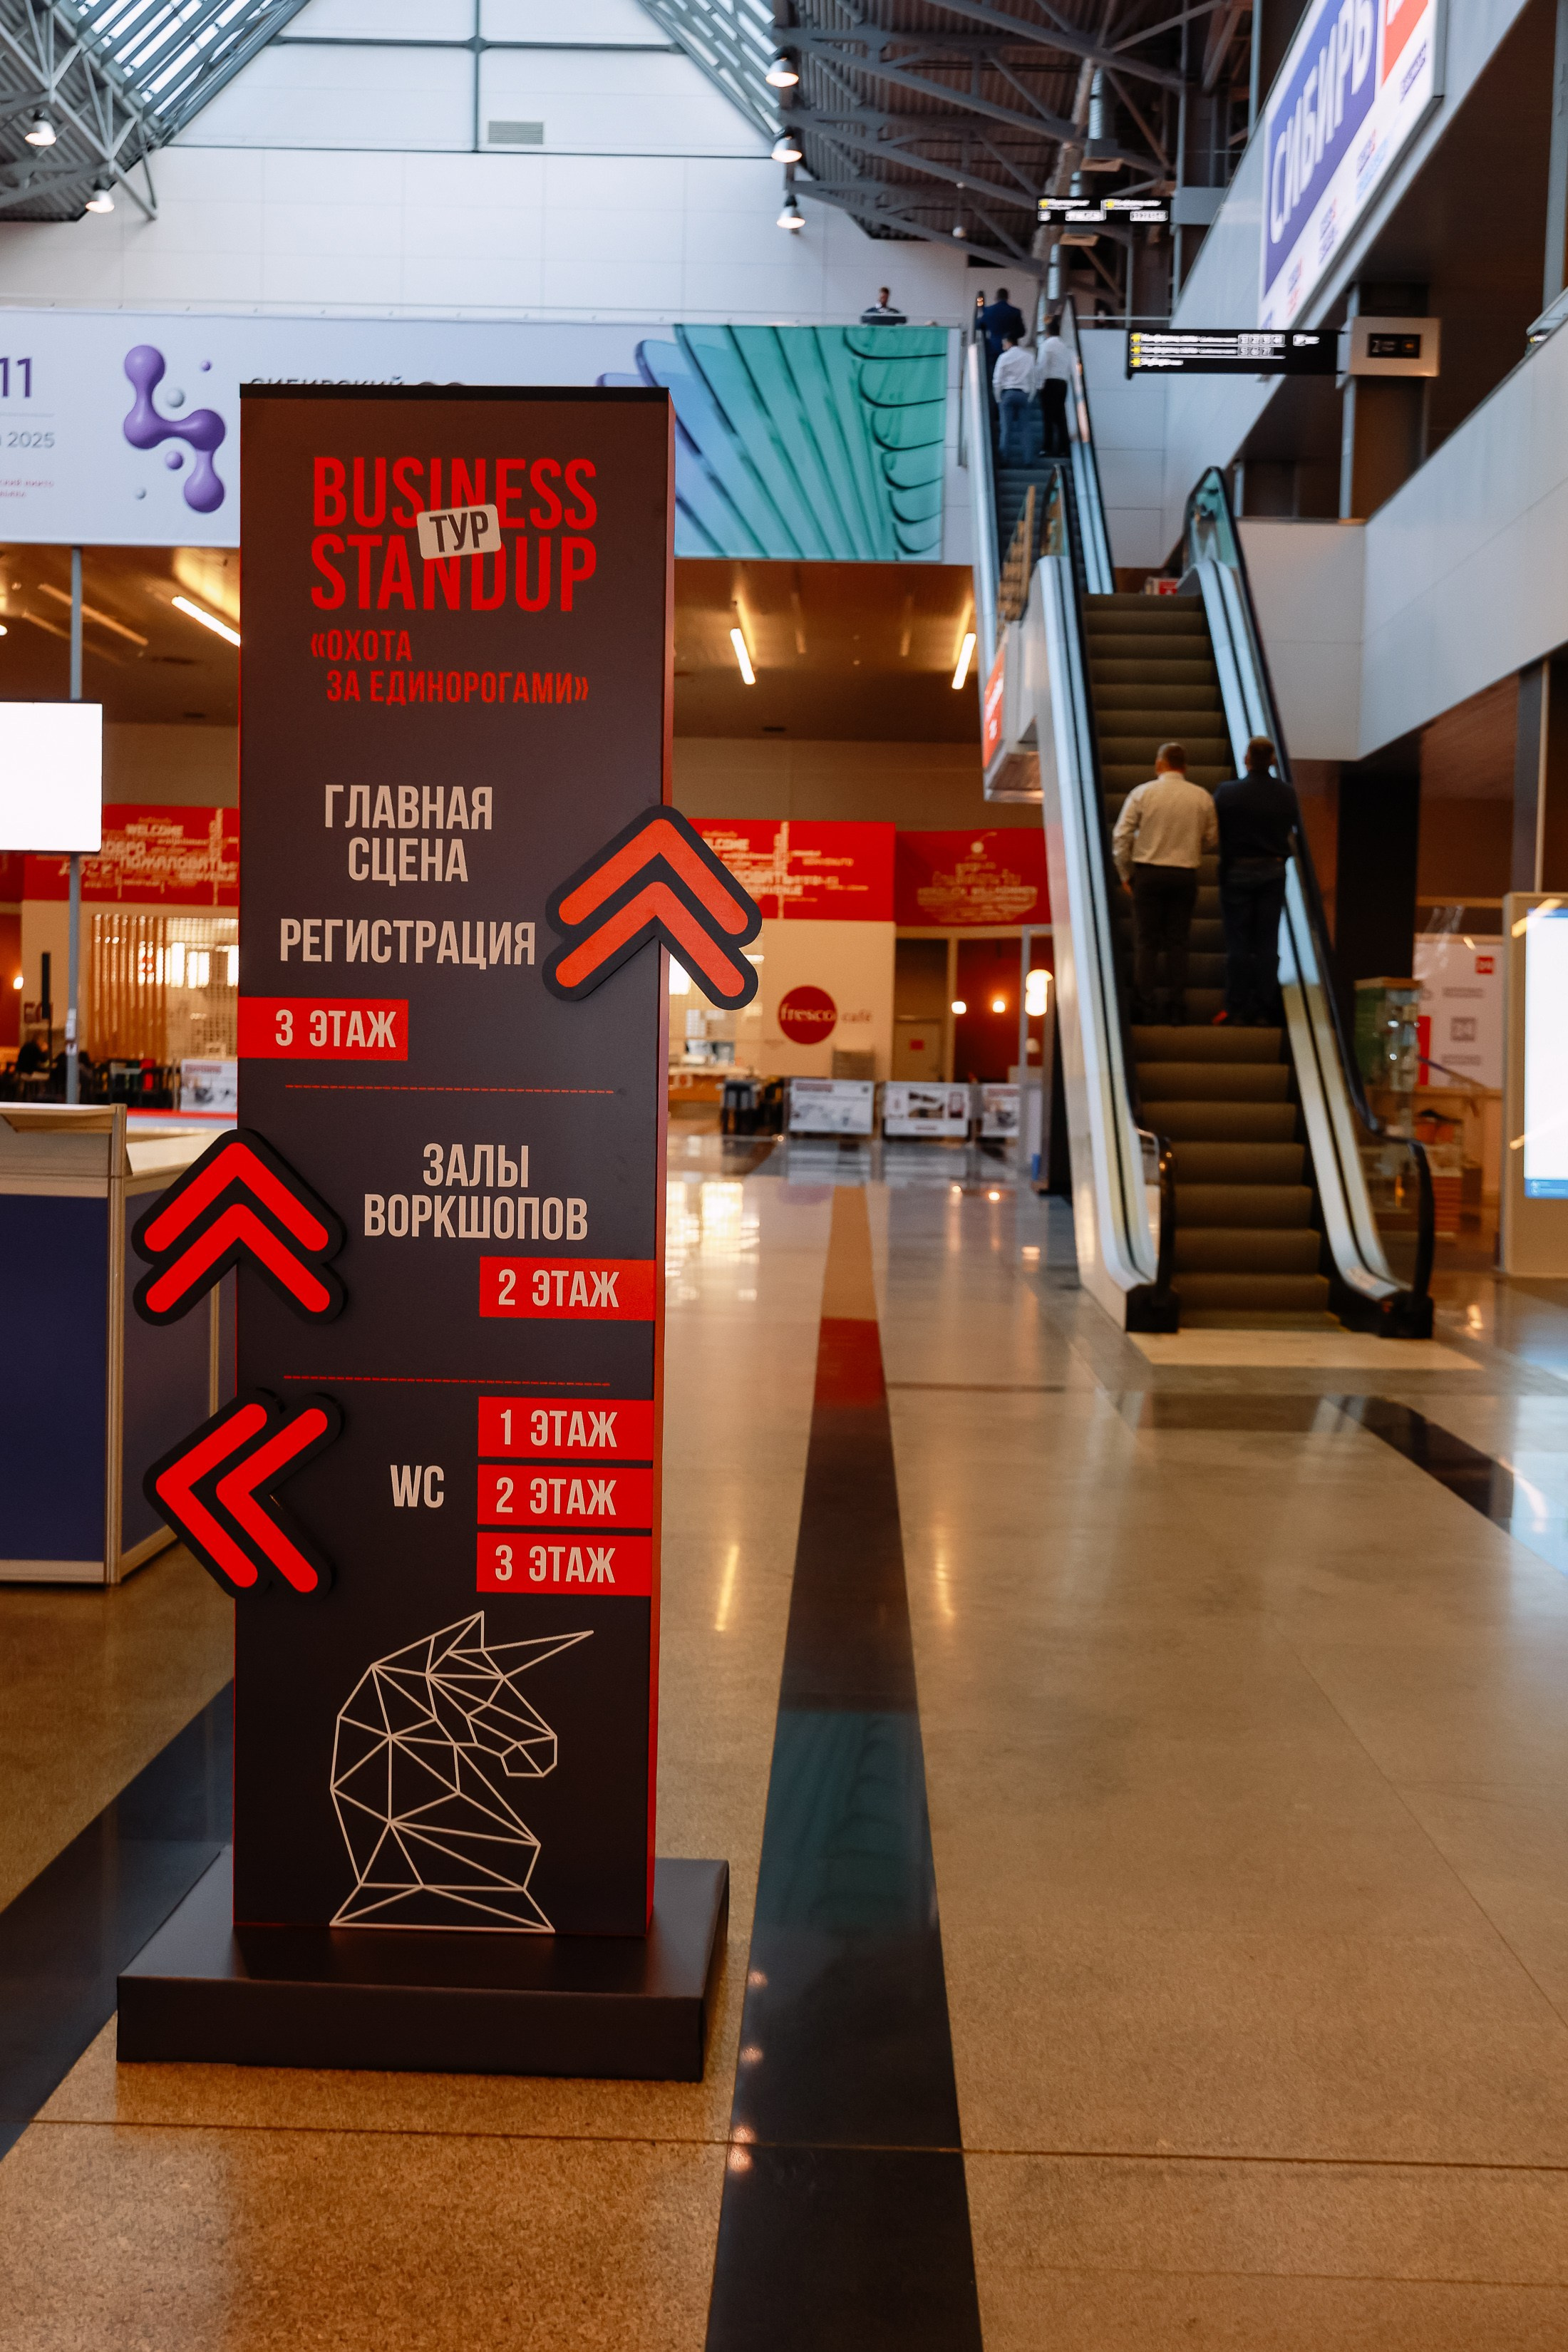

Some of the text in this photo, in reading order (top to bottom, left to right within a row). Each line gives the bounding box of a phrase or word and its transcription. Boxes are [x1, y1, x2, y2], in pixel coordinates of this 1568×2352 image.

[7, 431, 56, 448] 2025
[314, 457, 597, 530] BUSINESS
[429, 511, 489, 553] ТУР
[311, 535, 597, 612] STANDUP
[311, 629, 413, 661] «ОХОТА
[326, 670, 589, 706] ЗА ЕДИНОРОГАМИ»
[325, 785, 492, 830] ГЛАВНАЯ
[349, 837, 468, 886] СЦЕНА
[281, 919, 535, 970] РЕГИСТРАЦИЯ
[275, 1009, 396, 1048] 3 ЭТАЖ
[780, 1002, 837, 1022] fresco
[423, 1143, 529, 1187] ЗАЛЫ
[364, 1194, 588, 1240] ВОРКШОПОВ
[498, 1269, 619, 1307] 2 ЭТАЖ
[500, 1409, 618, 1448] 1 ЭТАЖ
[390, 1465, 445, 1508] WC
[496, 1477, 617, 1515] 2 ЭТАЖ
[495, 1545, 616, 1583] 3 ЭТАЖ
